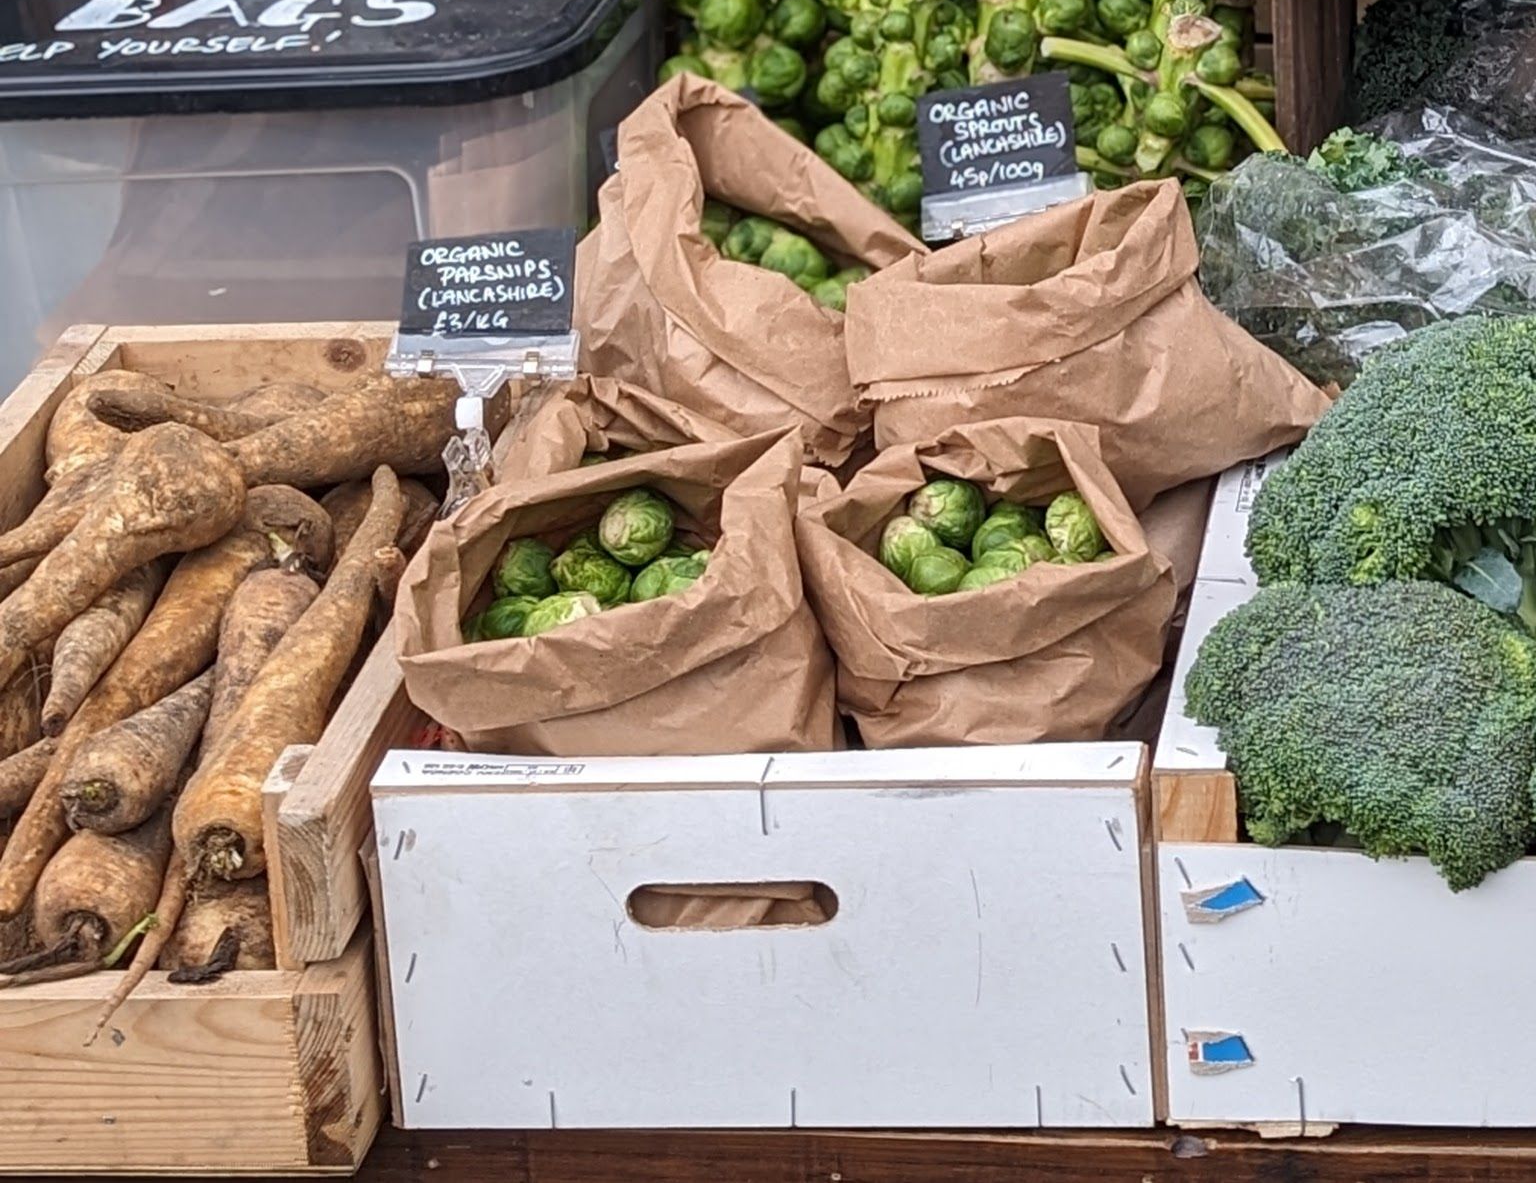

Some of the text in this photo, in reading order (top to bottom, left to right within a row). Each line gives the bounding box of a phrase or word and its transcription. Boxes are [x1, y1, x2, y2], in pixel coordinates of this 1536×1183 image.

[929, 92, 1030, 123] ORGANIC
[954, 112, 1043, 142] SPROUTS
[950, 161, 1043, 188] 45p/100g
[420, 241, 525, 266] ORGANIC
[437, 259, 552, 287] PARSNIPS
[418, 275, 566, 310] (LANCASHIRE)
